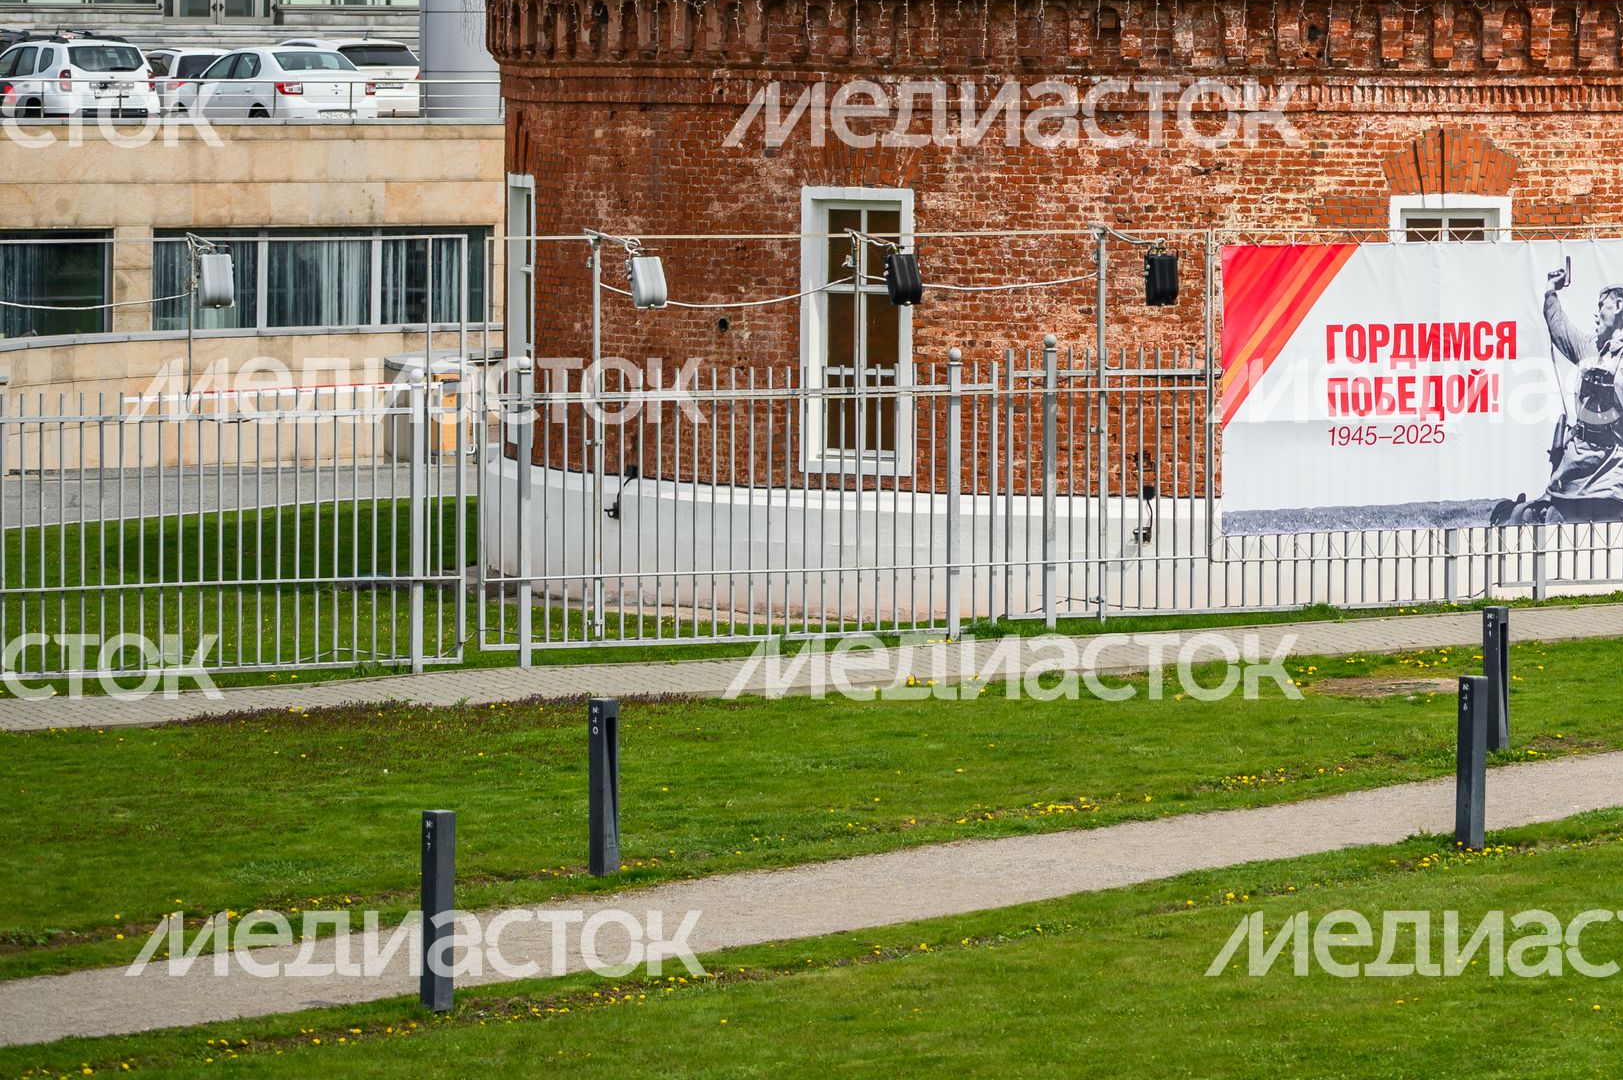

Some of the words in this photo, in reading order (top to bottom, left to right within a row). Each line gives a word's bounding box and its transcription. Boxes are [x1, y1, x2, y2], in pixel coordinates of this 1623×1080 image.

[1326, 321, 1516, 369] ГОРДИМСЯ
[1327, 369, 1499, 421] ПОБЕДОЙ!
[1328, 424, 1445, 446] 1945–2025
